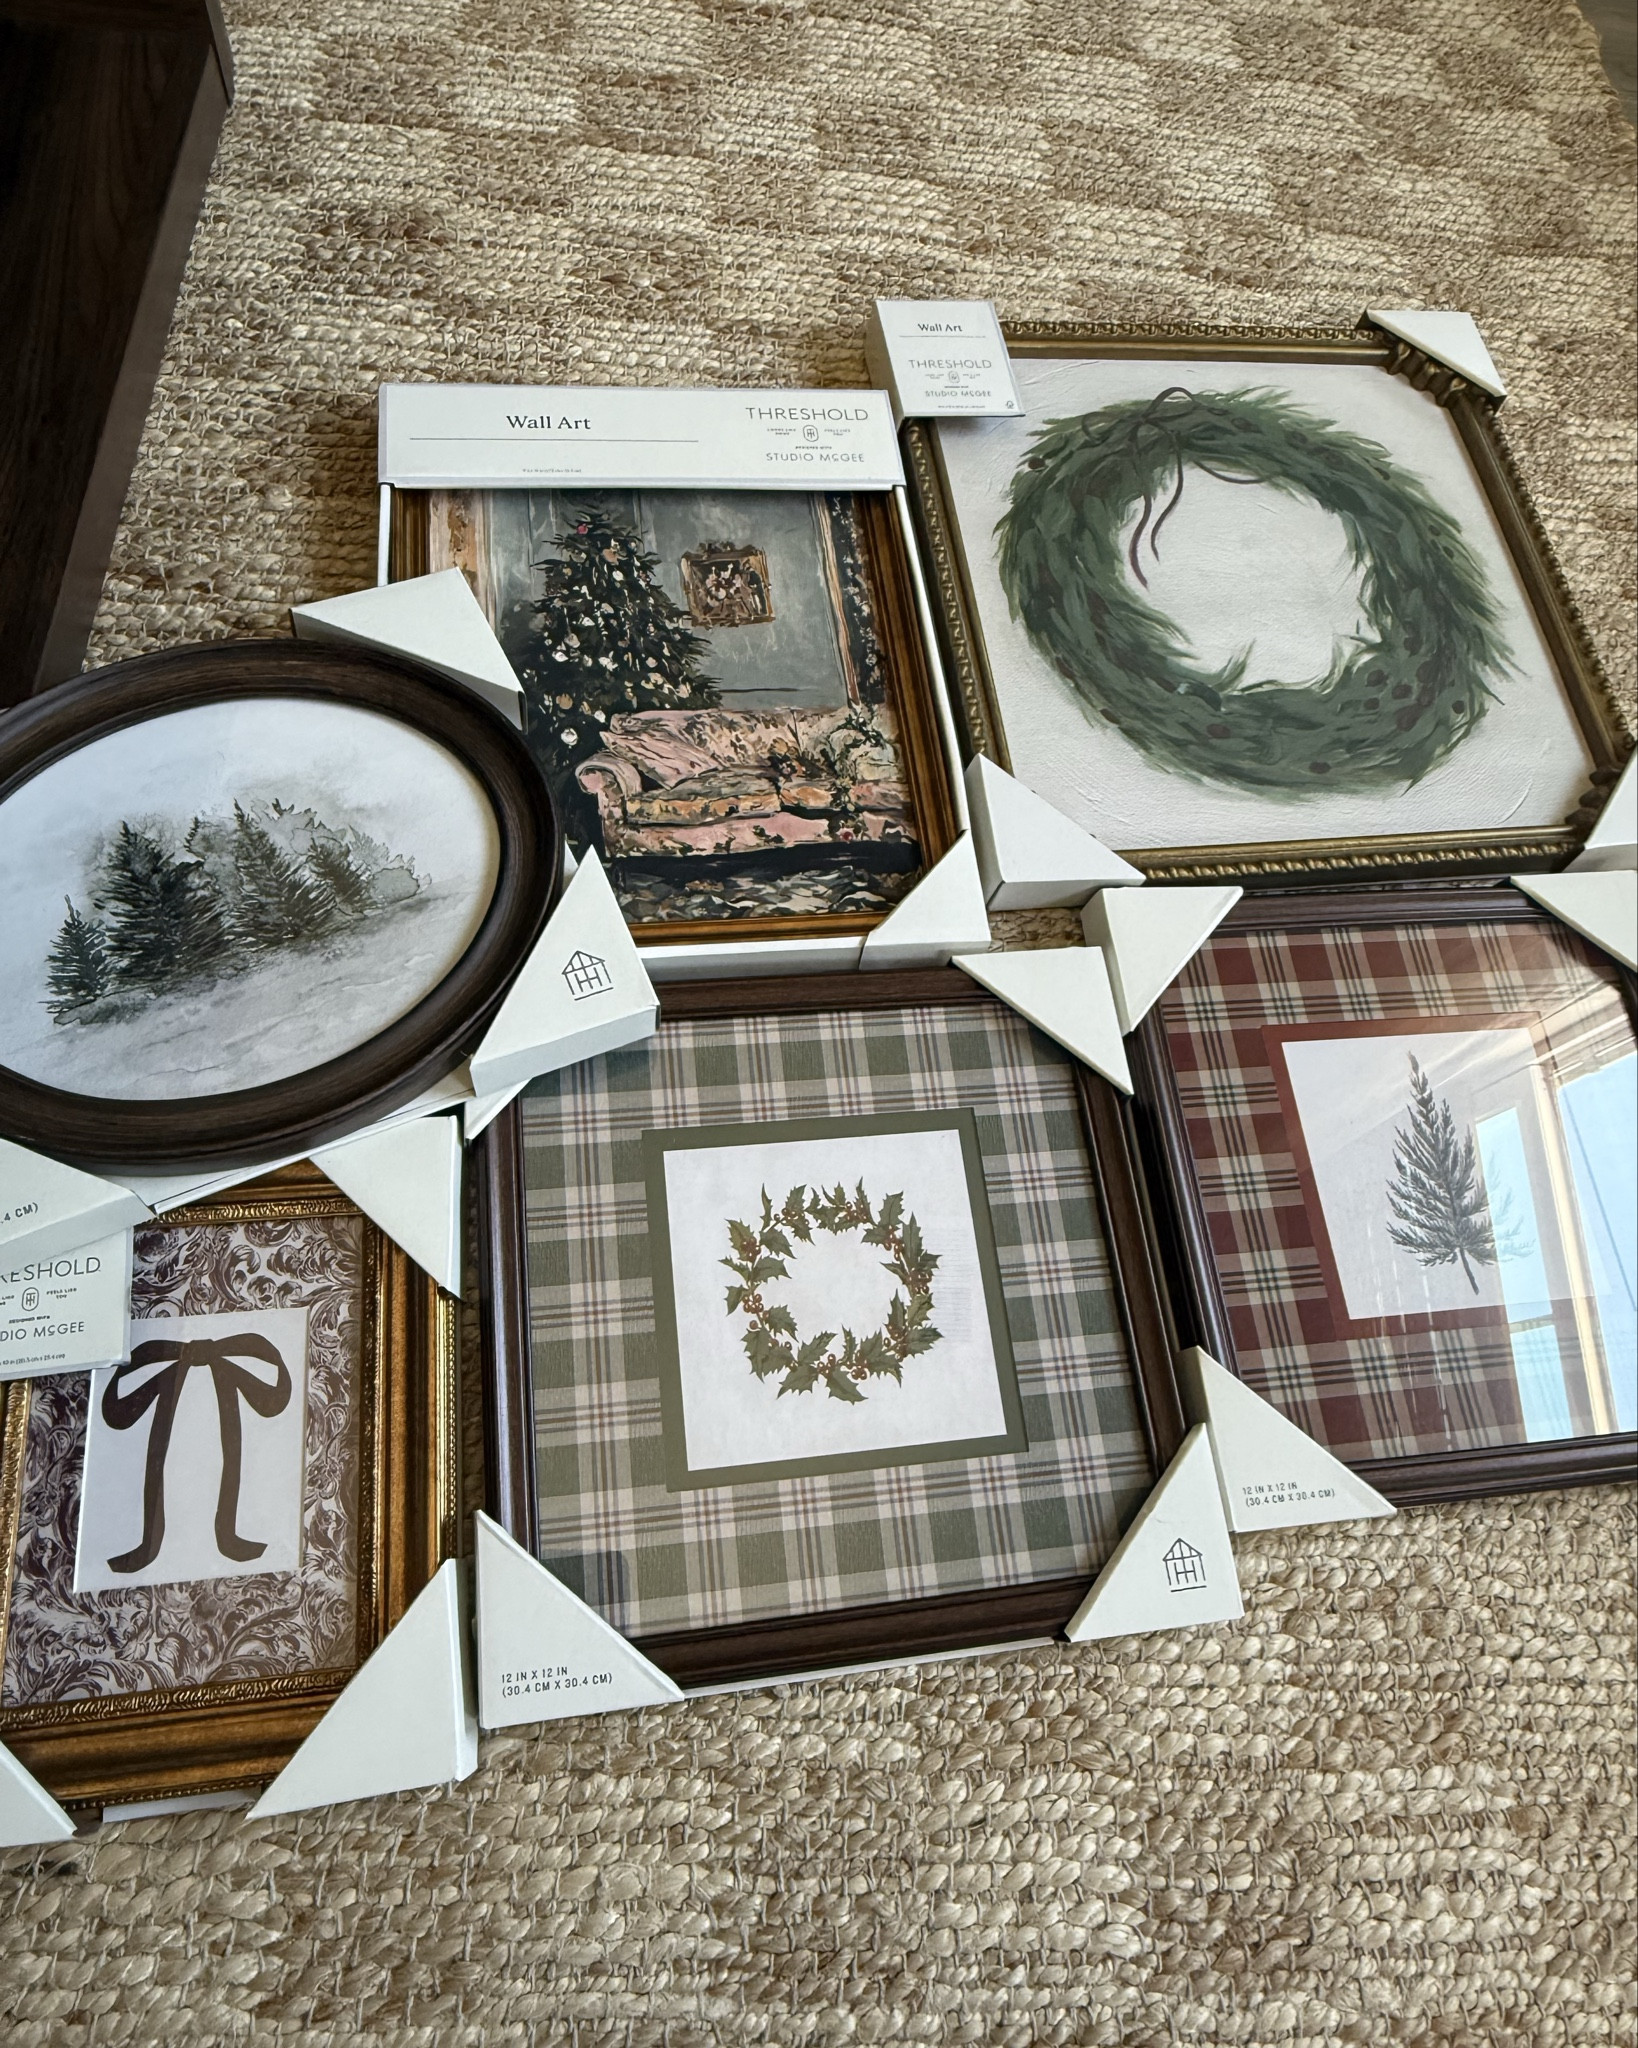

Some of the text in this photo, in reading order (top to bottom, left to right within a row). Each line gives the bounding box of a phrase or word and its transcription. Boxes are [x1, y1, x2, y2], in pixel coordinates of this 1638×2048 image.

[918, 323, 963, 332] Wall Art
[908, 359, 992, 369] THRESHOLD
[745, 407, 869, 421] THRESHOLD
[506, 415, 591, 430] Wall Art
[766, 453, 814, 462] STUDIO
[15, 1202, 39, 1218] CM)
[1242, 1487, 1252, 1495] 12
[1255, 1485, 1265, 1494] IN
[1267, 1484, 1273, 1492] X
[1275, 1483, 1286, 1492] 12
[1245, 1487, 1336, 1507] (30.4 CM X 30.4 CM)
[502, 1666, 568, 1684] 12 IN X 12 IN
[502, 1672, 613, 1698] (30.4 CM X 30.4 CM)
